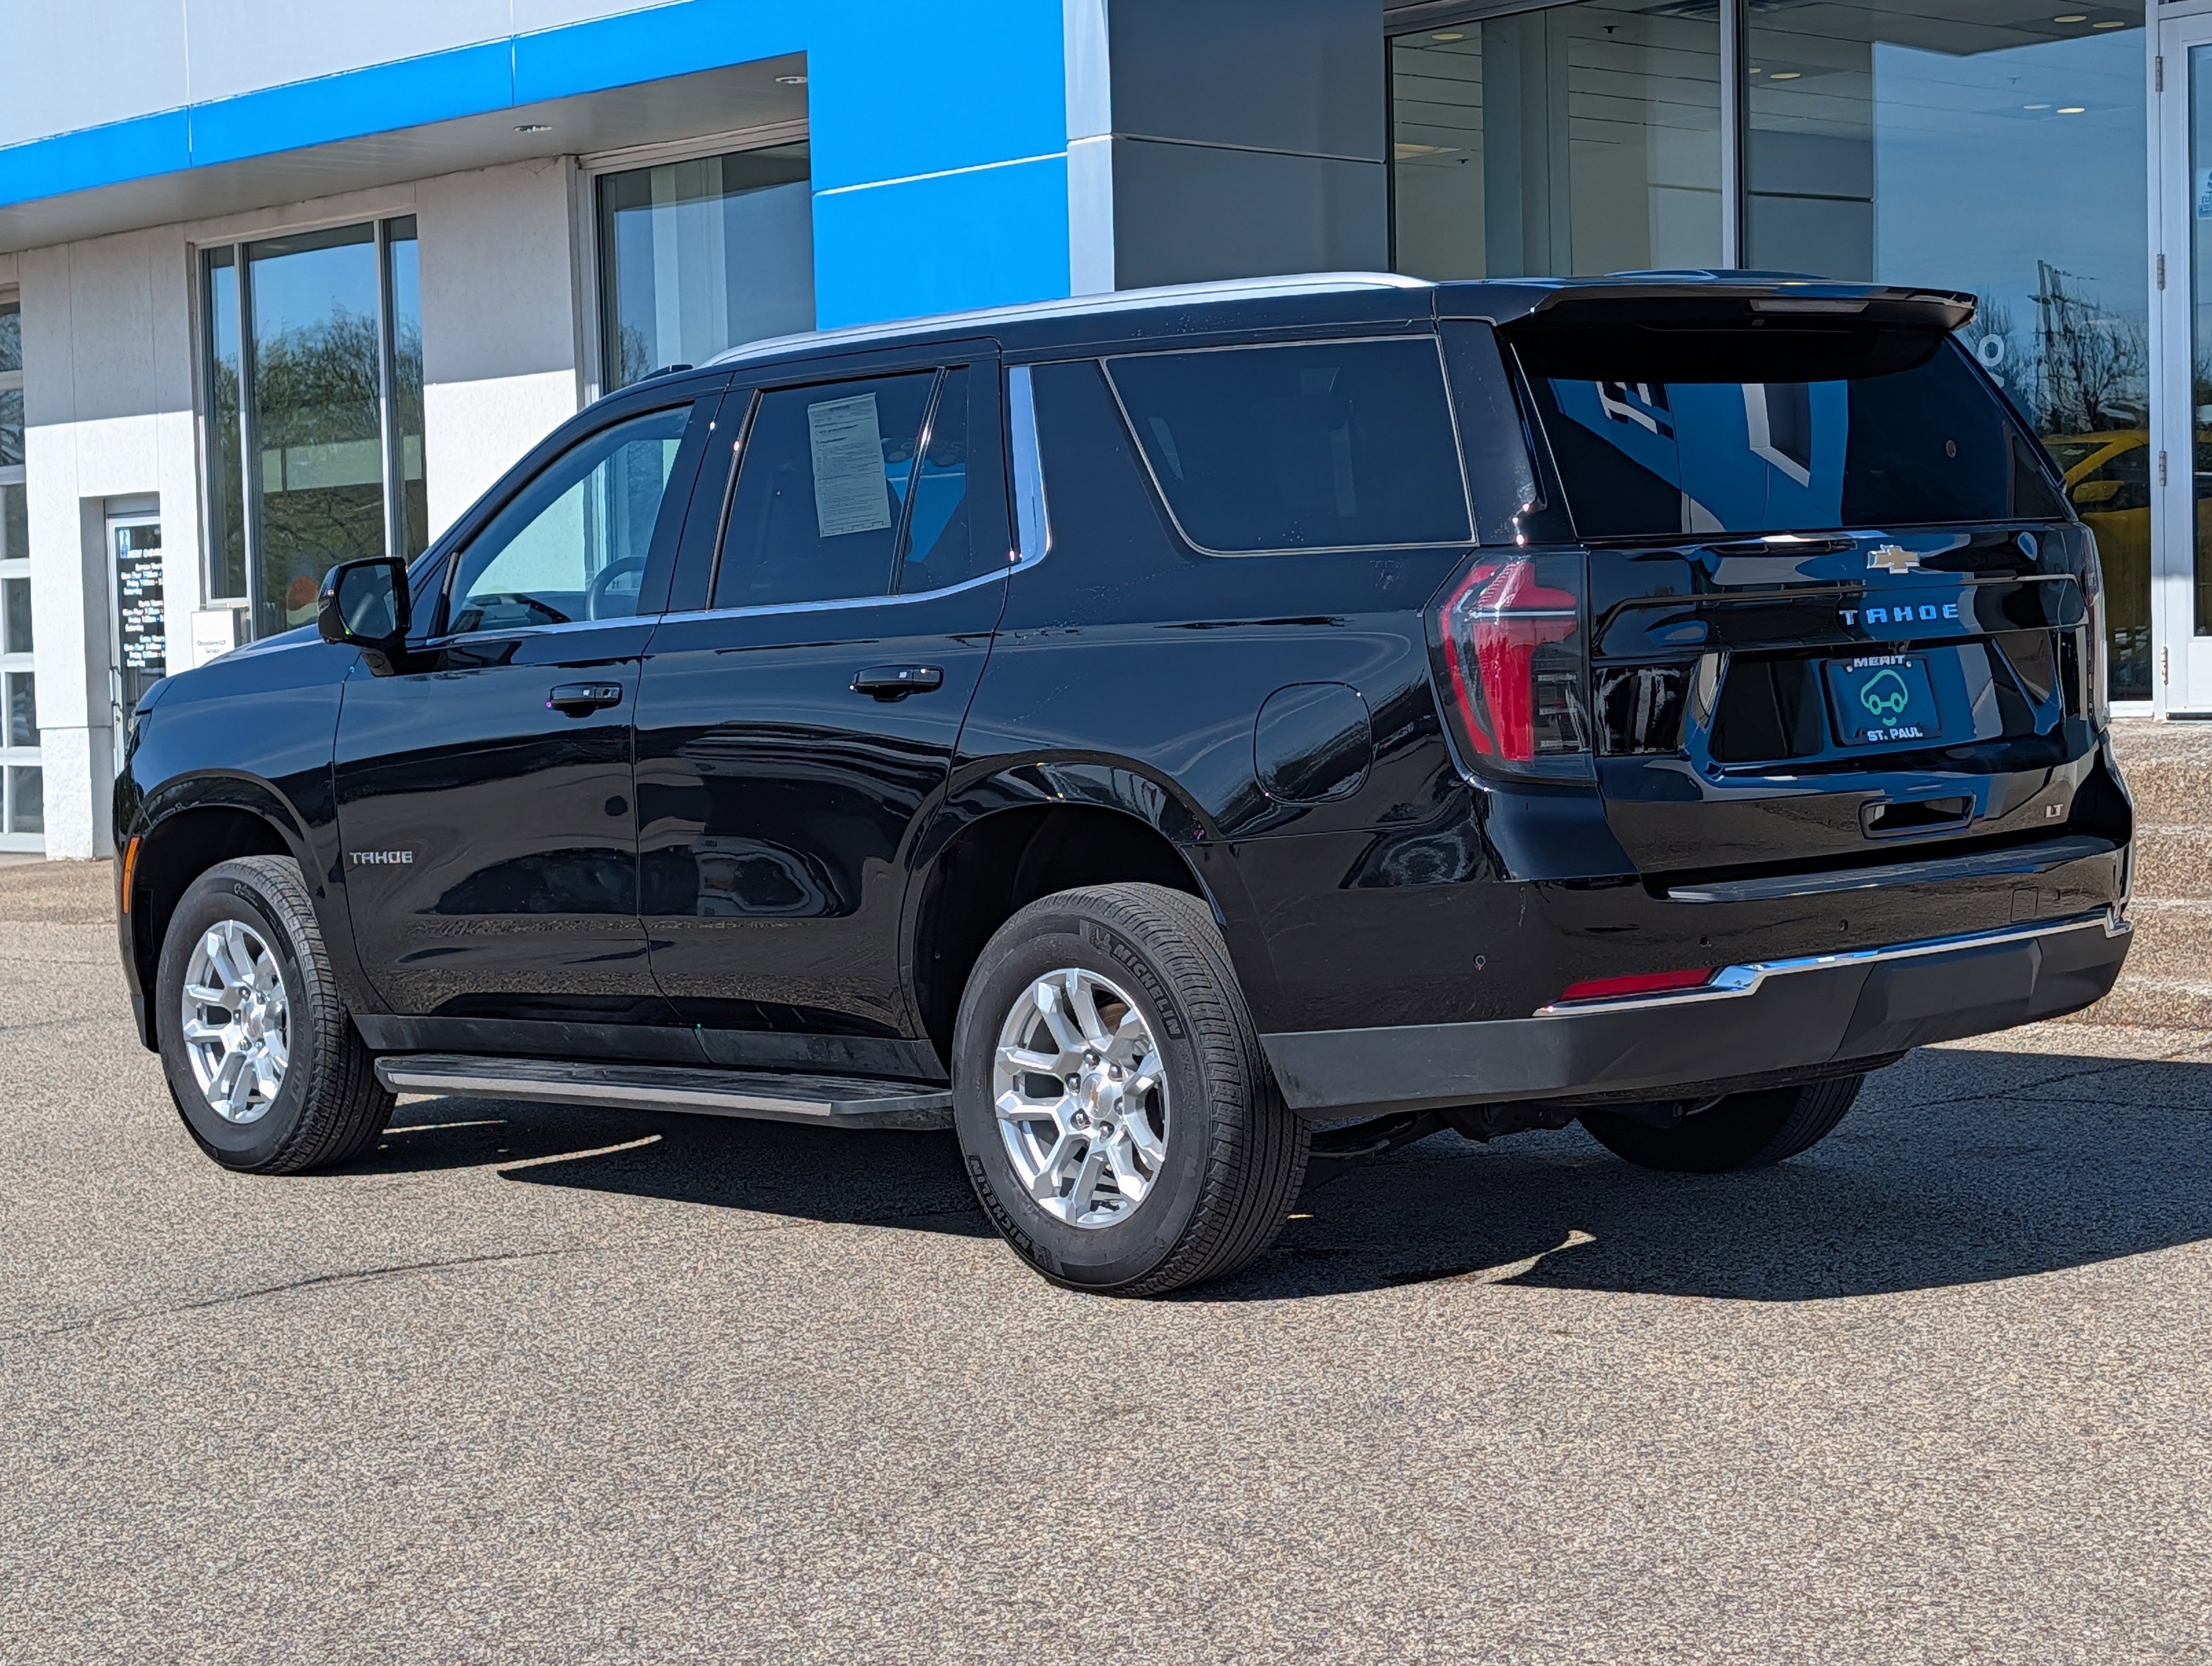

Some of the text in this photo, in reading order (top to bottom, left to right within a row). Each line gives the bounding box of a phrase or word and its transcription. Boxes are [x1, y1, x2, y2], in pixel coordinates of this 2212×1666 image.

[1838, 603, 1960, 626] TAHOE
[1854, 654, 1906, 668] MERIT
[1867, 727, 1924, 741] ST. PAUL
[2046, 804, 2063, 818] LT
[349, 850, 413, 864] TAHOE
[1113, 944, 1182, 1035] MICHELIN
[970, 1159, 1031, 1250] MICHELIN
